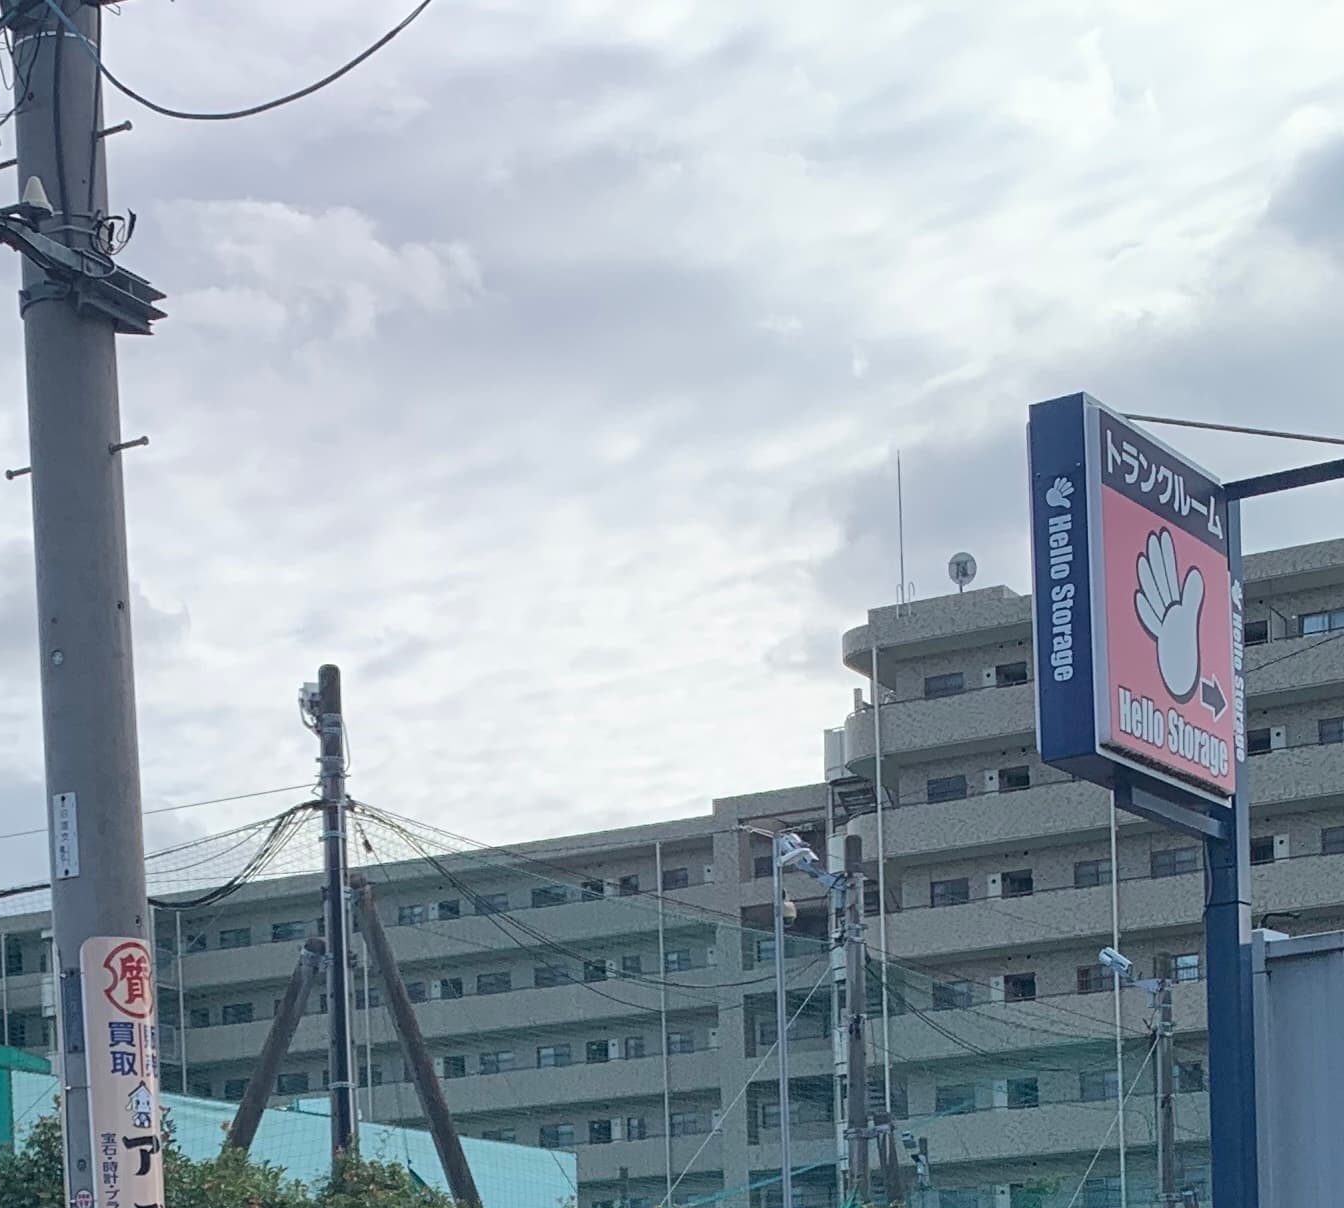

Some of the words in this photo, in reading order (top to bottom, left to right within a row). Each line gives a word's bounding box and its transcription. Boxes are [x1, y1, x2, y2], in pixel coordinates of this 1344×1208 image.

[1105, 429, 1224, 540] トランクルーム
[1047, 512, 1073, 580] Hello
[1052, 584, 1074, 682] Storage
[1118, 686, 1164, 748] Hello
[1167, 709, 1229, 778] Storage
[108, 1021, 138, 1076] 買取
